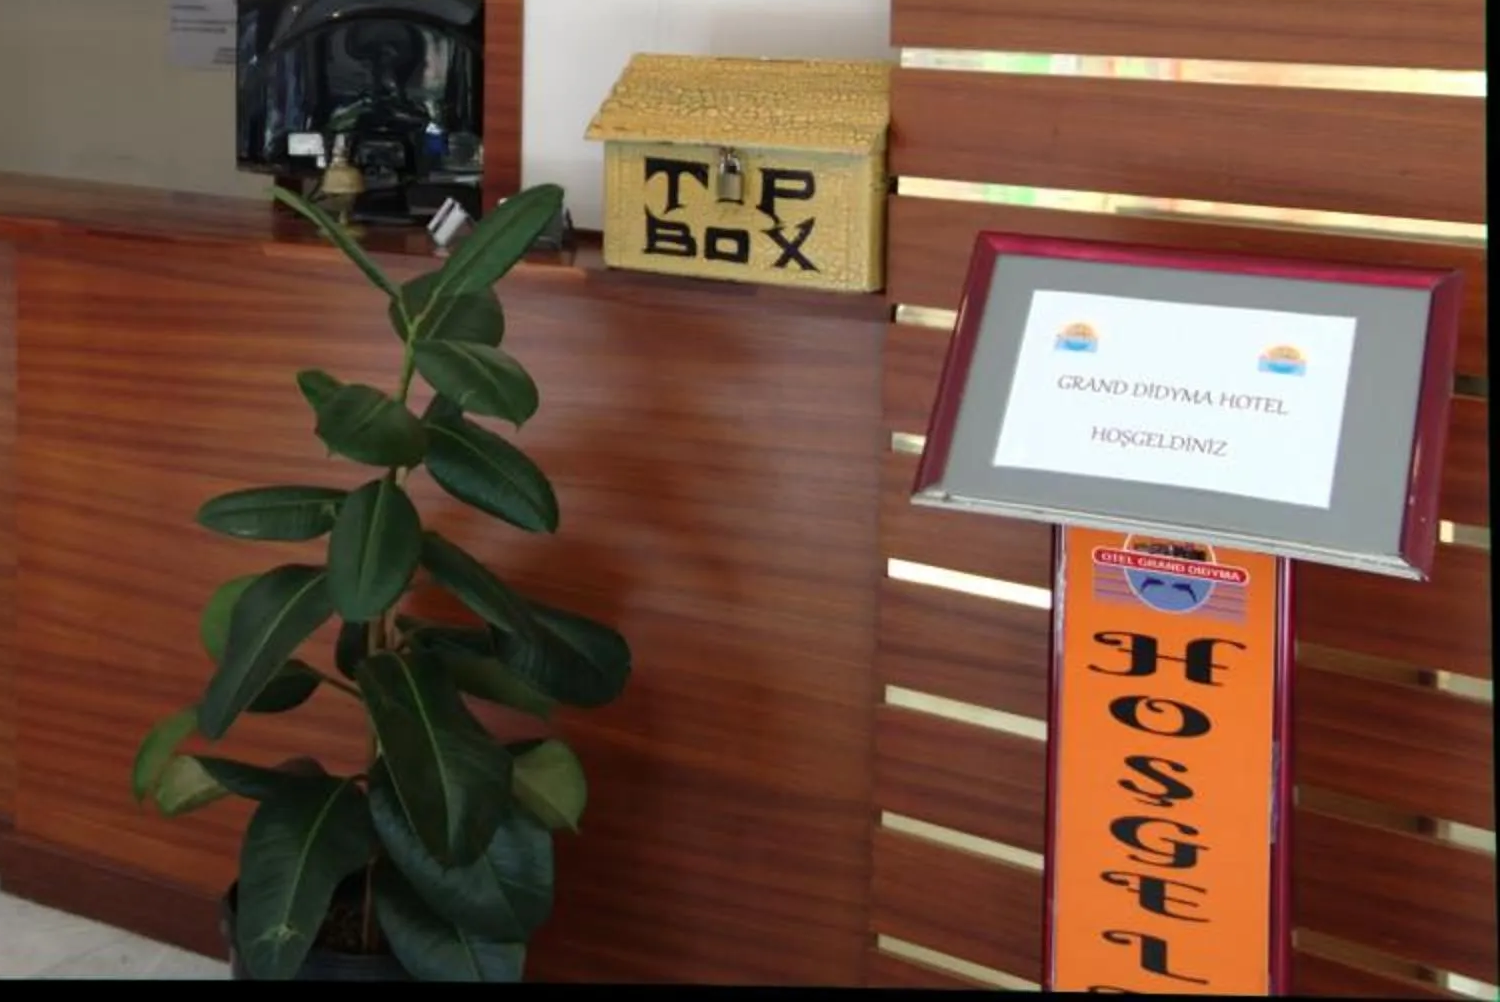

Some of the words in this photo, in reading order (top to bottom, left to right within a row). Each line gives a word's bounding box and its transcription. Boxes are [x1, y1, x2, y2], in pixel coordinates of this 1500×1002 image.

[644, 156, 816, 227] TP
[643, 204, 819, 272] BOX
[1057, 373, 1129, 396] GRAND
[1219, 392, 1288, 416] HOTEL
[1101, 551, 1135, 565] OTEL
[1137, 557, 1186, 573] GRAND
[1087, 630, 1247, 994] HOŞGEL
